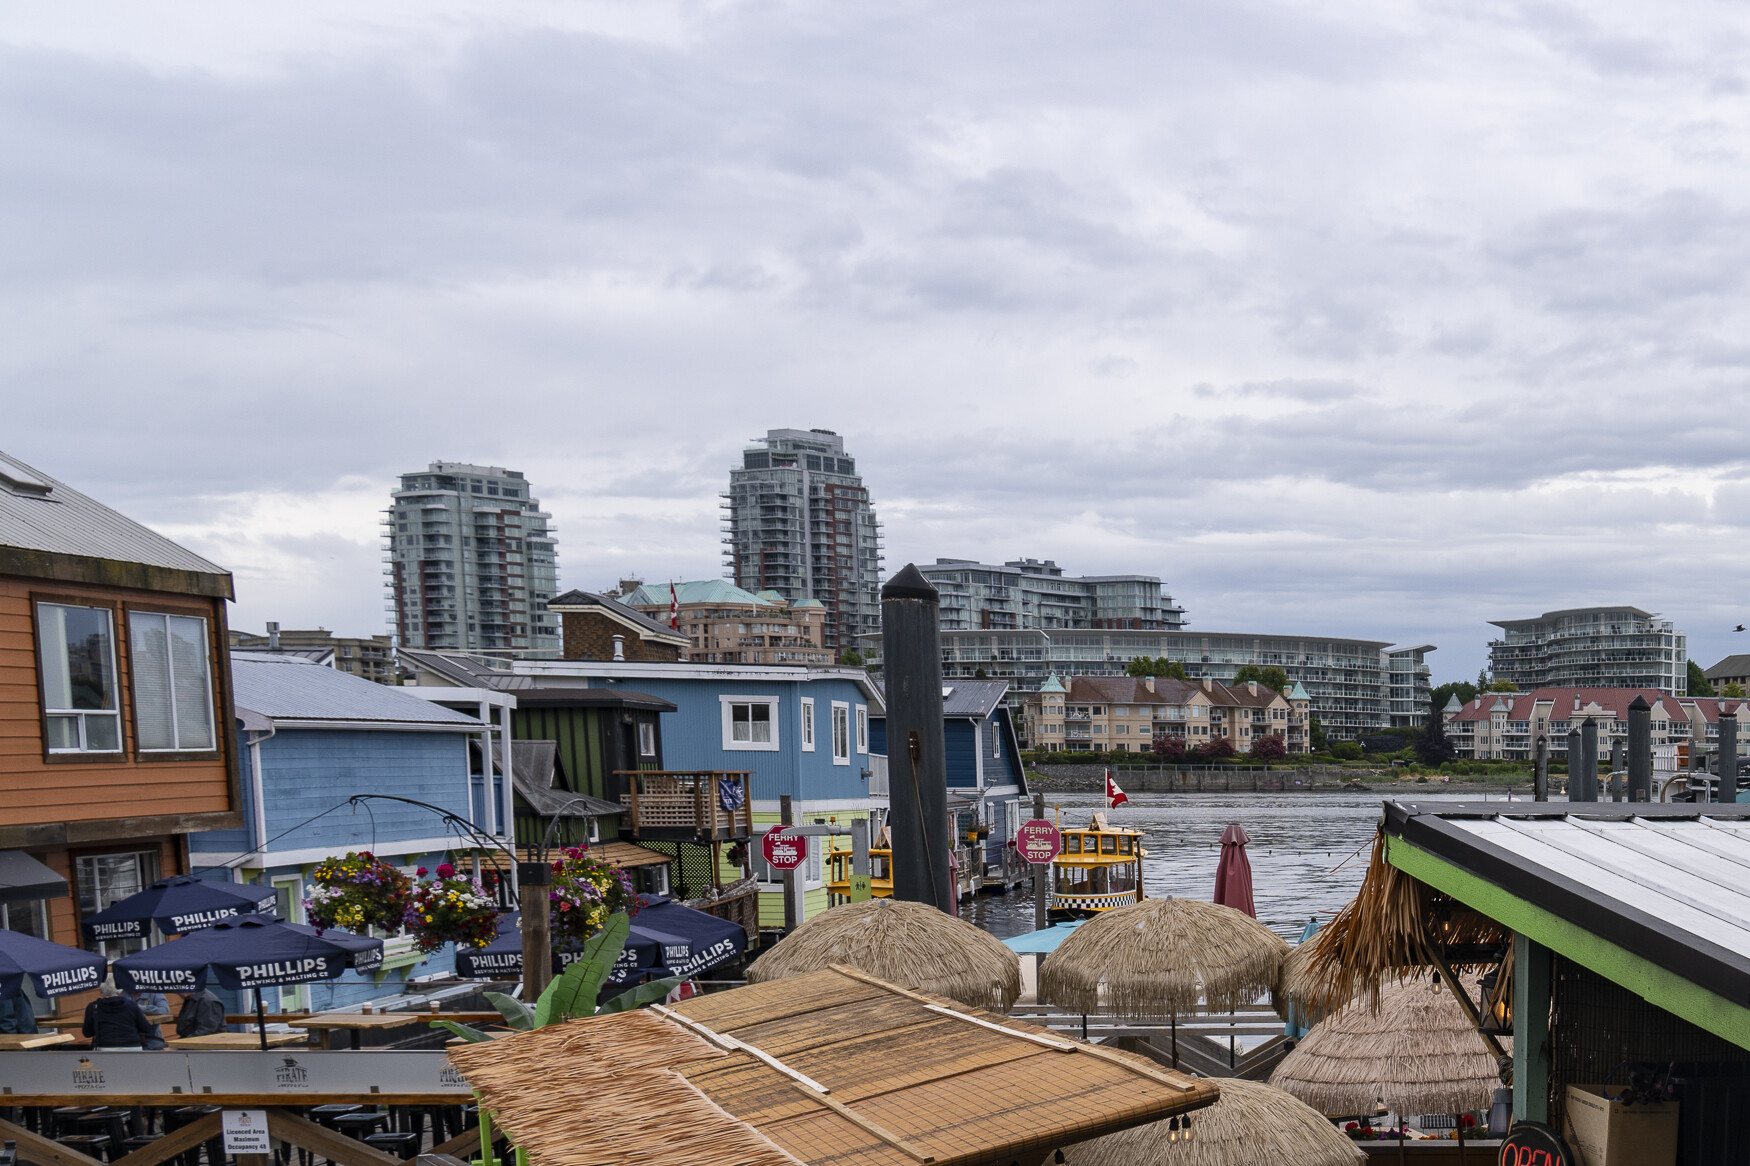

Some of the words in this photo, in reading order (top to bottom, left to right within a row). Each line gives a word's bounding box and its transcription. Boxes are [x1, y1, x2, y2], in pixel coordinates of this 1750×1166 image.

[769, 833, 798, 841] FERRY
[1024, 826, 1054, 835] FERRY
[772, 855, 797, 863] STOP
[1027, 851, 1051, 859] STOP
[171, 908, 238, 927] PHILLIPS
[93, 921, 140, 935] PHILLIPS
[469, 953, 523, 968] PHILLIPS
[235, 957, 327, 980] PHILLIPS
[41, 966, 98, 988] PHILLIPS
[129, 970, 196, 984] PHILLIPS
[241, 978, 276, 987] BREWING
[285, 973, 317, 982] MALTING
[72, 1070, 106, 1084] PIRATE
